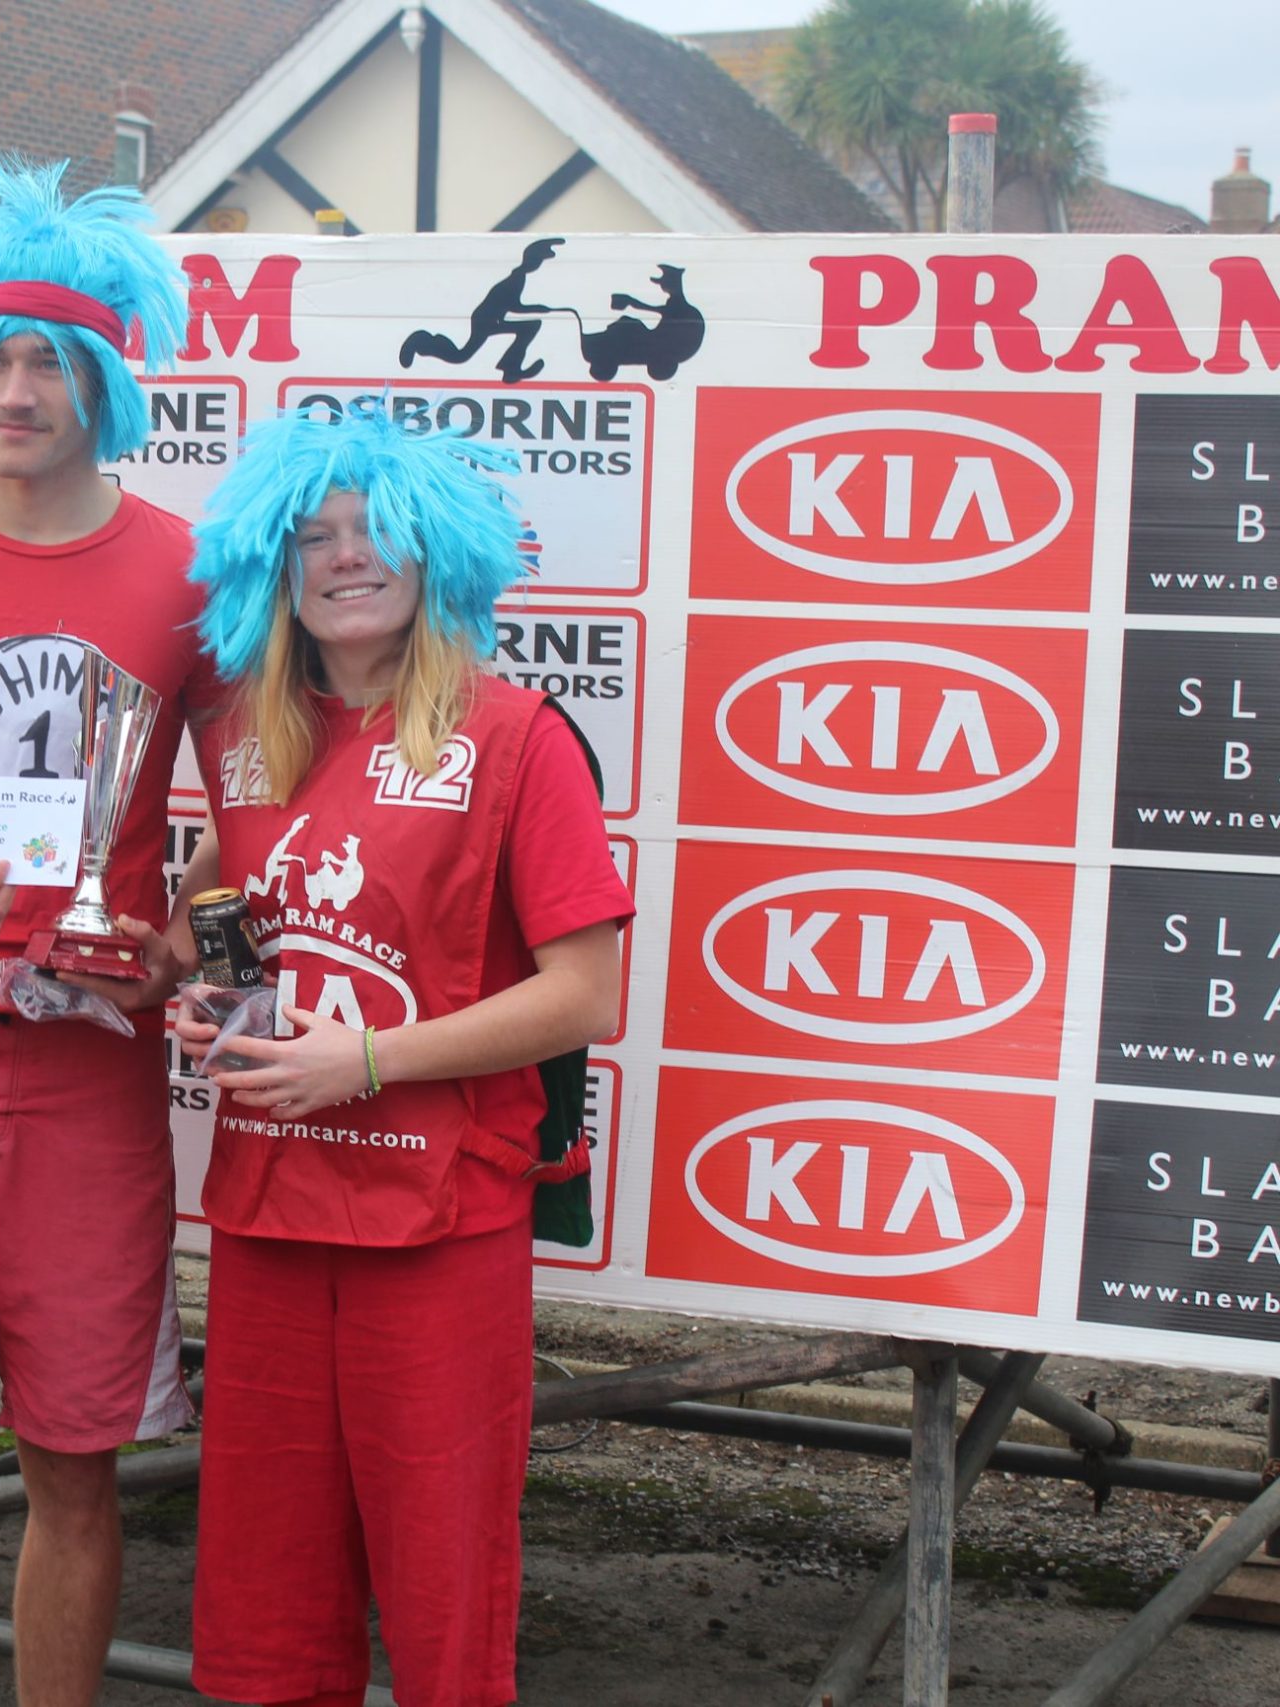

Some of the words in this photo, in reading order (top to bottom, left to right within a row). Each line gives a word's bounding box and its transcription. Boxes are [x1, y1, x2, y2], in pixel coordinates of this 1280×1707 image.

[787, 452, 1014, 542] KIA
[18, 710, 60, 779] 1
[776, 681, 1001, 775] KIA
[19, 790, 53, 804] Race
[365, 734, 478, 813] 12
[338, 922, 407, 971] RACE
[763, 907, 987, 1007] KIA
[745, 1136, 966, 1241] KIA
[1191, 1218, 1280, 1264] BA
